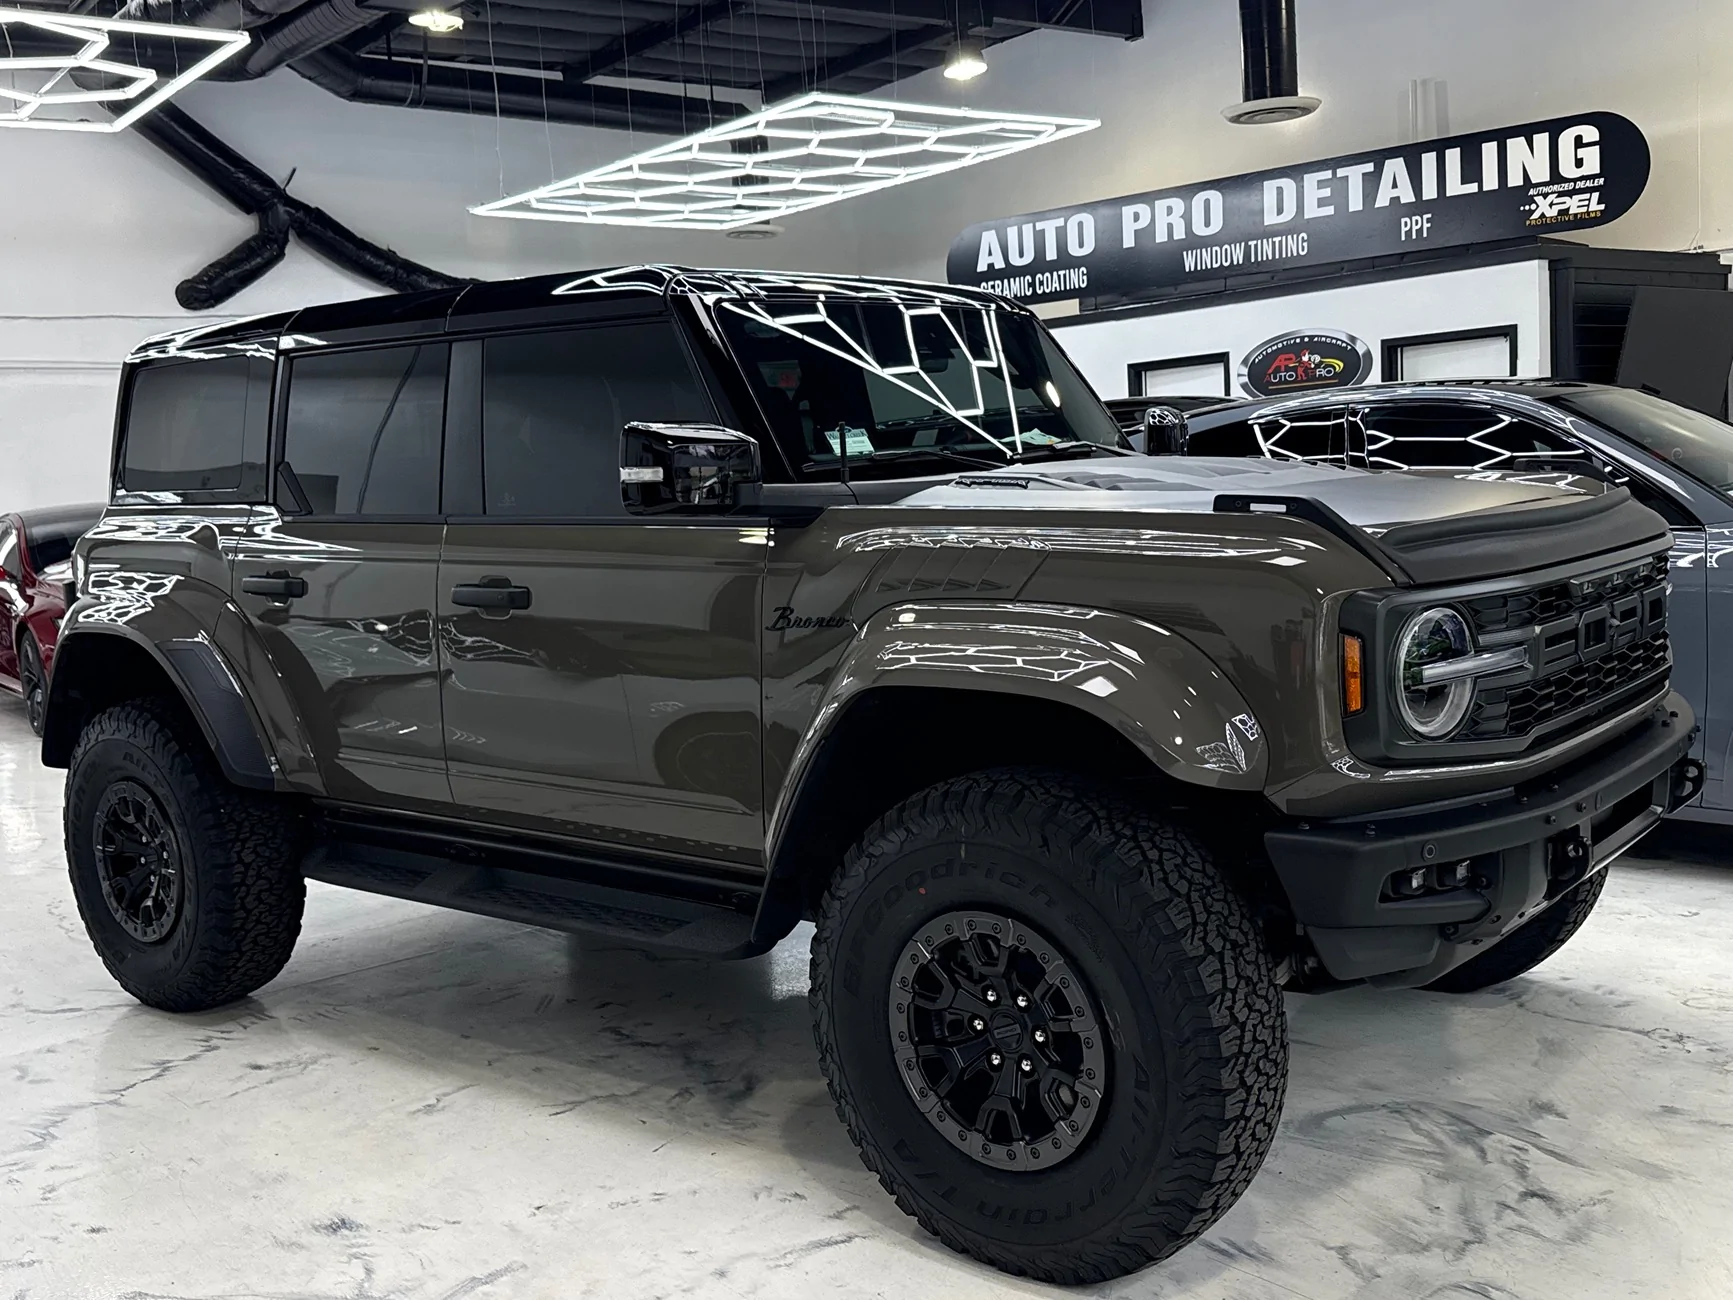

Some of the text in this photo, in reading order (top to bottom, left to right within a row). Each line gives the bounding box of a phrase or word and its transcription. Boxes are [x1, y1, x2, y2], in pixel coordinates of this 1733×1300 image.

[976, 124, 1601, 273] AUTO PRO DETAILING
[1527, 177, 1605, 196] AUTHORIZED DEALER
[1525, 210, 1602, 227] PROTECTIVE FILMS
[1529, 191, 1606, 220] XPEL
[1400, 213, 1432, 241] PPF
[1182, 232, 1308, 273] WINDOW TINTING
[1035, 266, 1088, 294] COATING
[1254, 337, 1301, 364] AUTOMOTIVE
[1313, 336, 1352, 351] AIRCRAFT
[1263, 367, 1335, 383] AUTO PRO
[765, 606, 850, 631] Bronco
[1536, 583, 1668, 679] FORD
